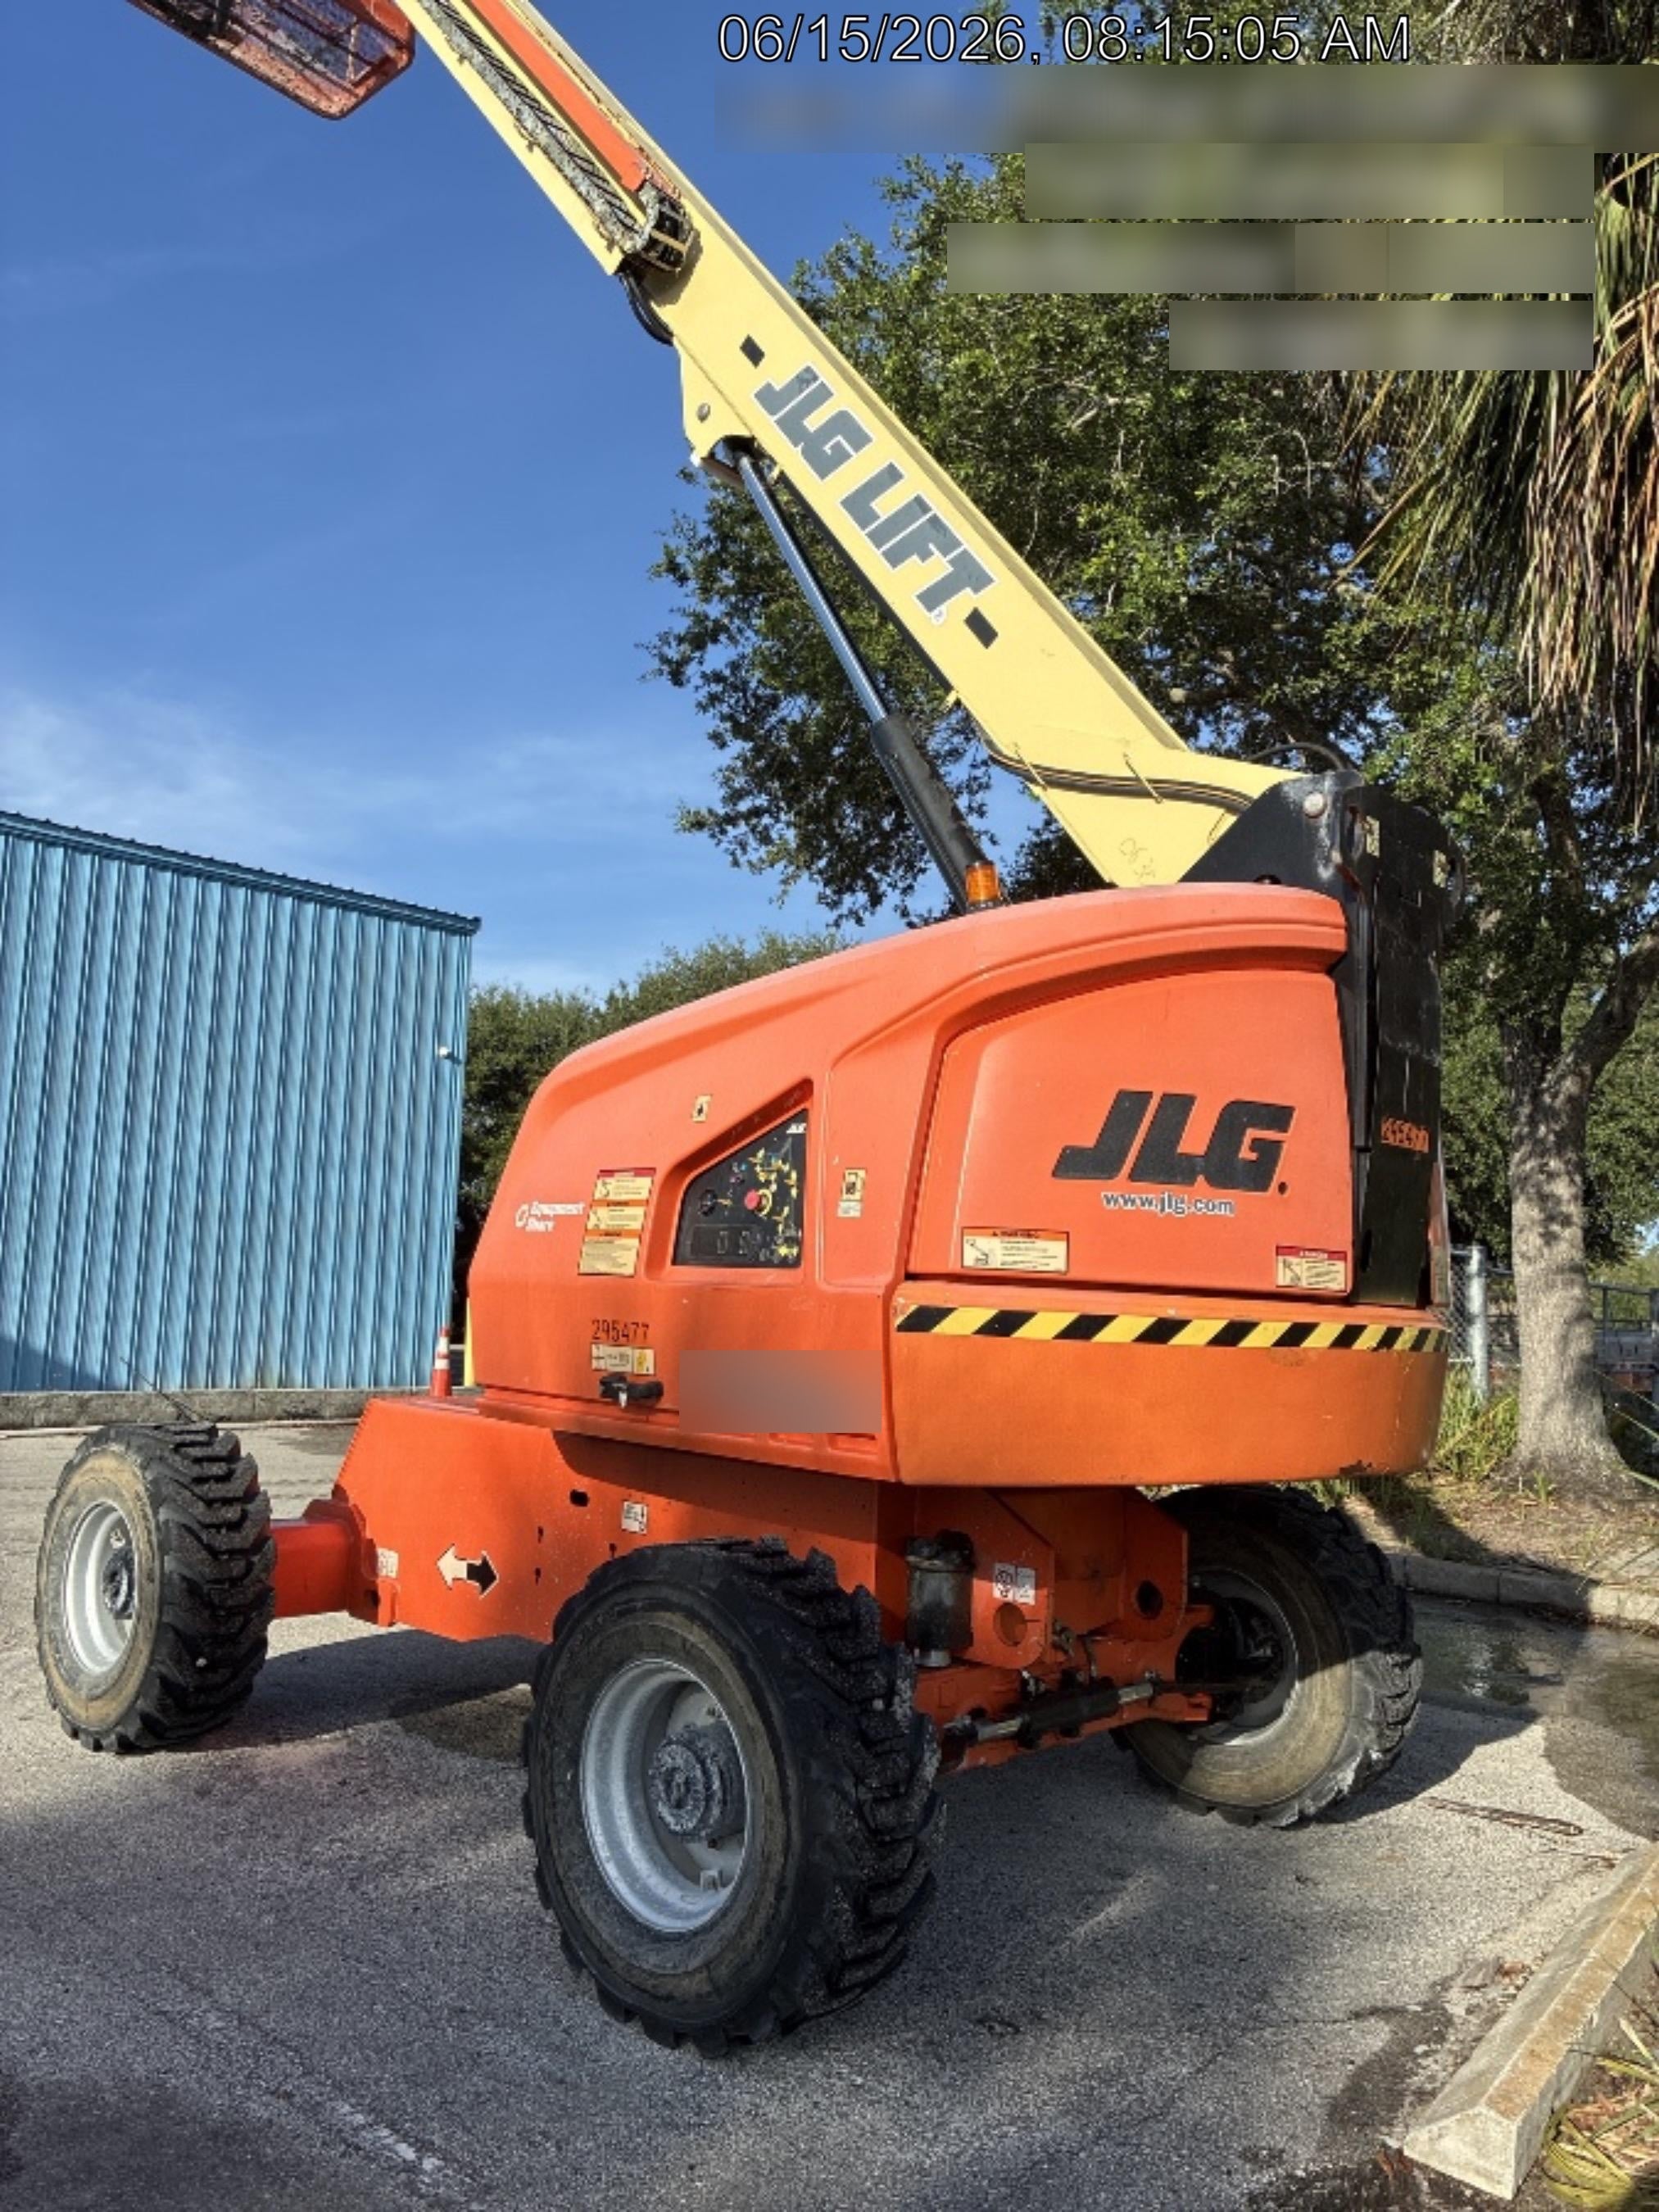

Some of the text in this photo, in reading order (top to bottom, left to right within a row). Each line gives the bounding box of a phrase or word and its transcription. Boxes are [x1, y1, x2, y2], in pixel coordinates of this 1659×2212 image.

[753, 364, 999, 614] JLG LIFT
[1051, 1088, 1296, 1194] JLG
[1101, 1190, 1235, 1218] www.jlg.com
[591, 1318, 650, 1344] 295477
